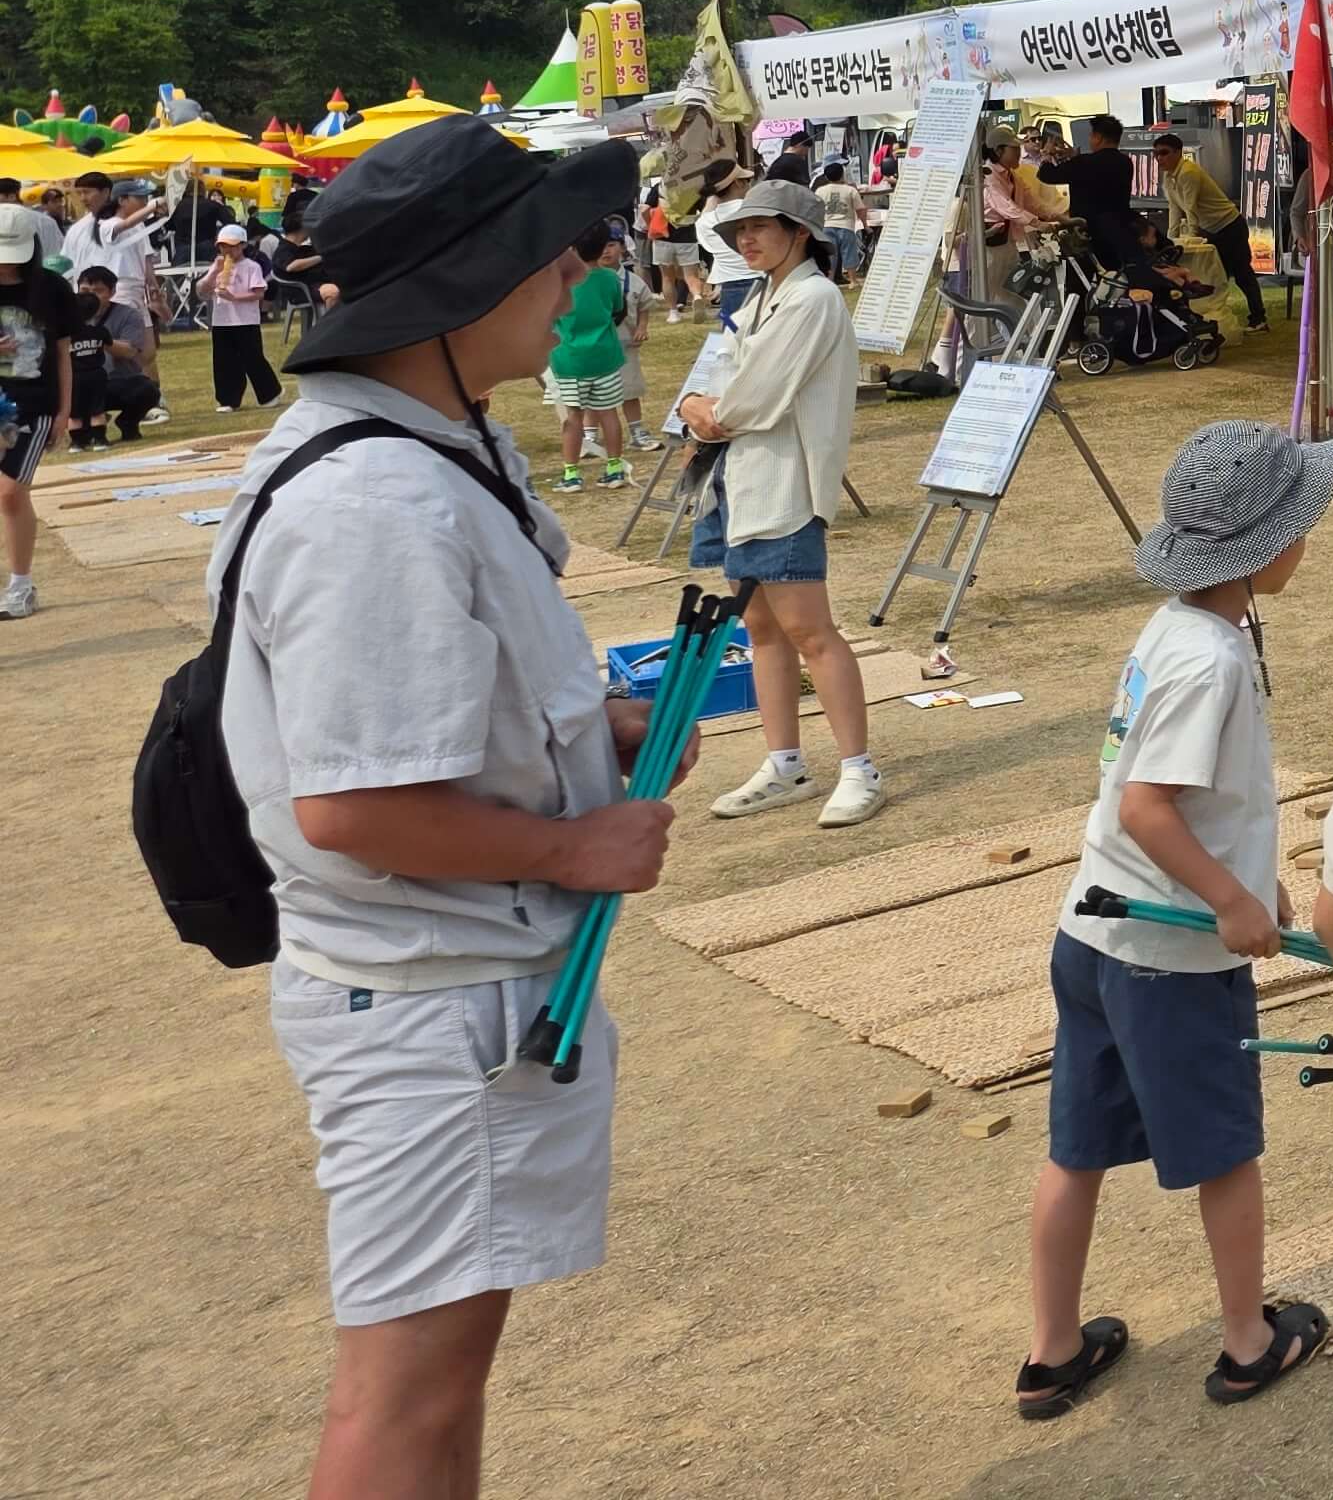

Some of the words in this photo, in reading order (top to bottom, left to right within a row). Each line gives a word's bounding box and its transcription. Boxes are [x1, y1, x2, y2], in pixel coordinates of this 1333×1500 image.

[1020, 19, 1085, 74] 어린이
[1082, 5, 1184, 67] 의상체험
[764, 57, 809, 100] 단오마당
[811, 49, 892, 98] 무료생수나눔
[70, 339, 103, 352] OREA
